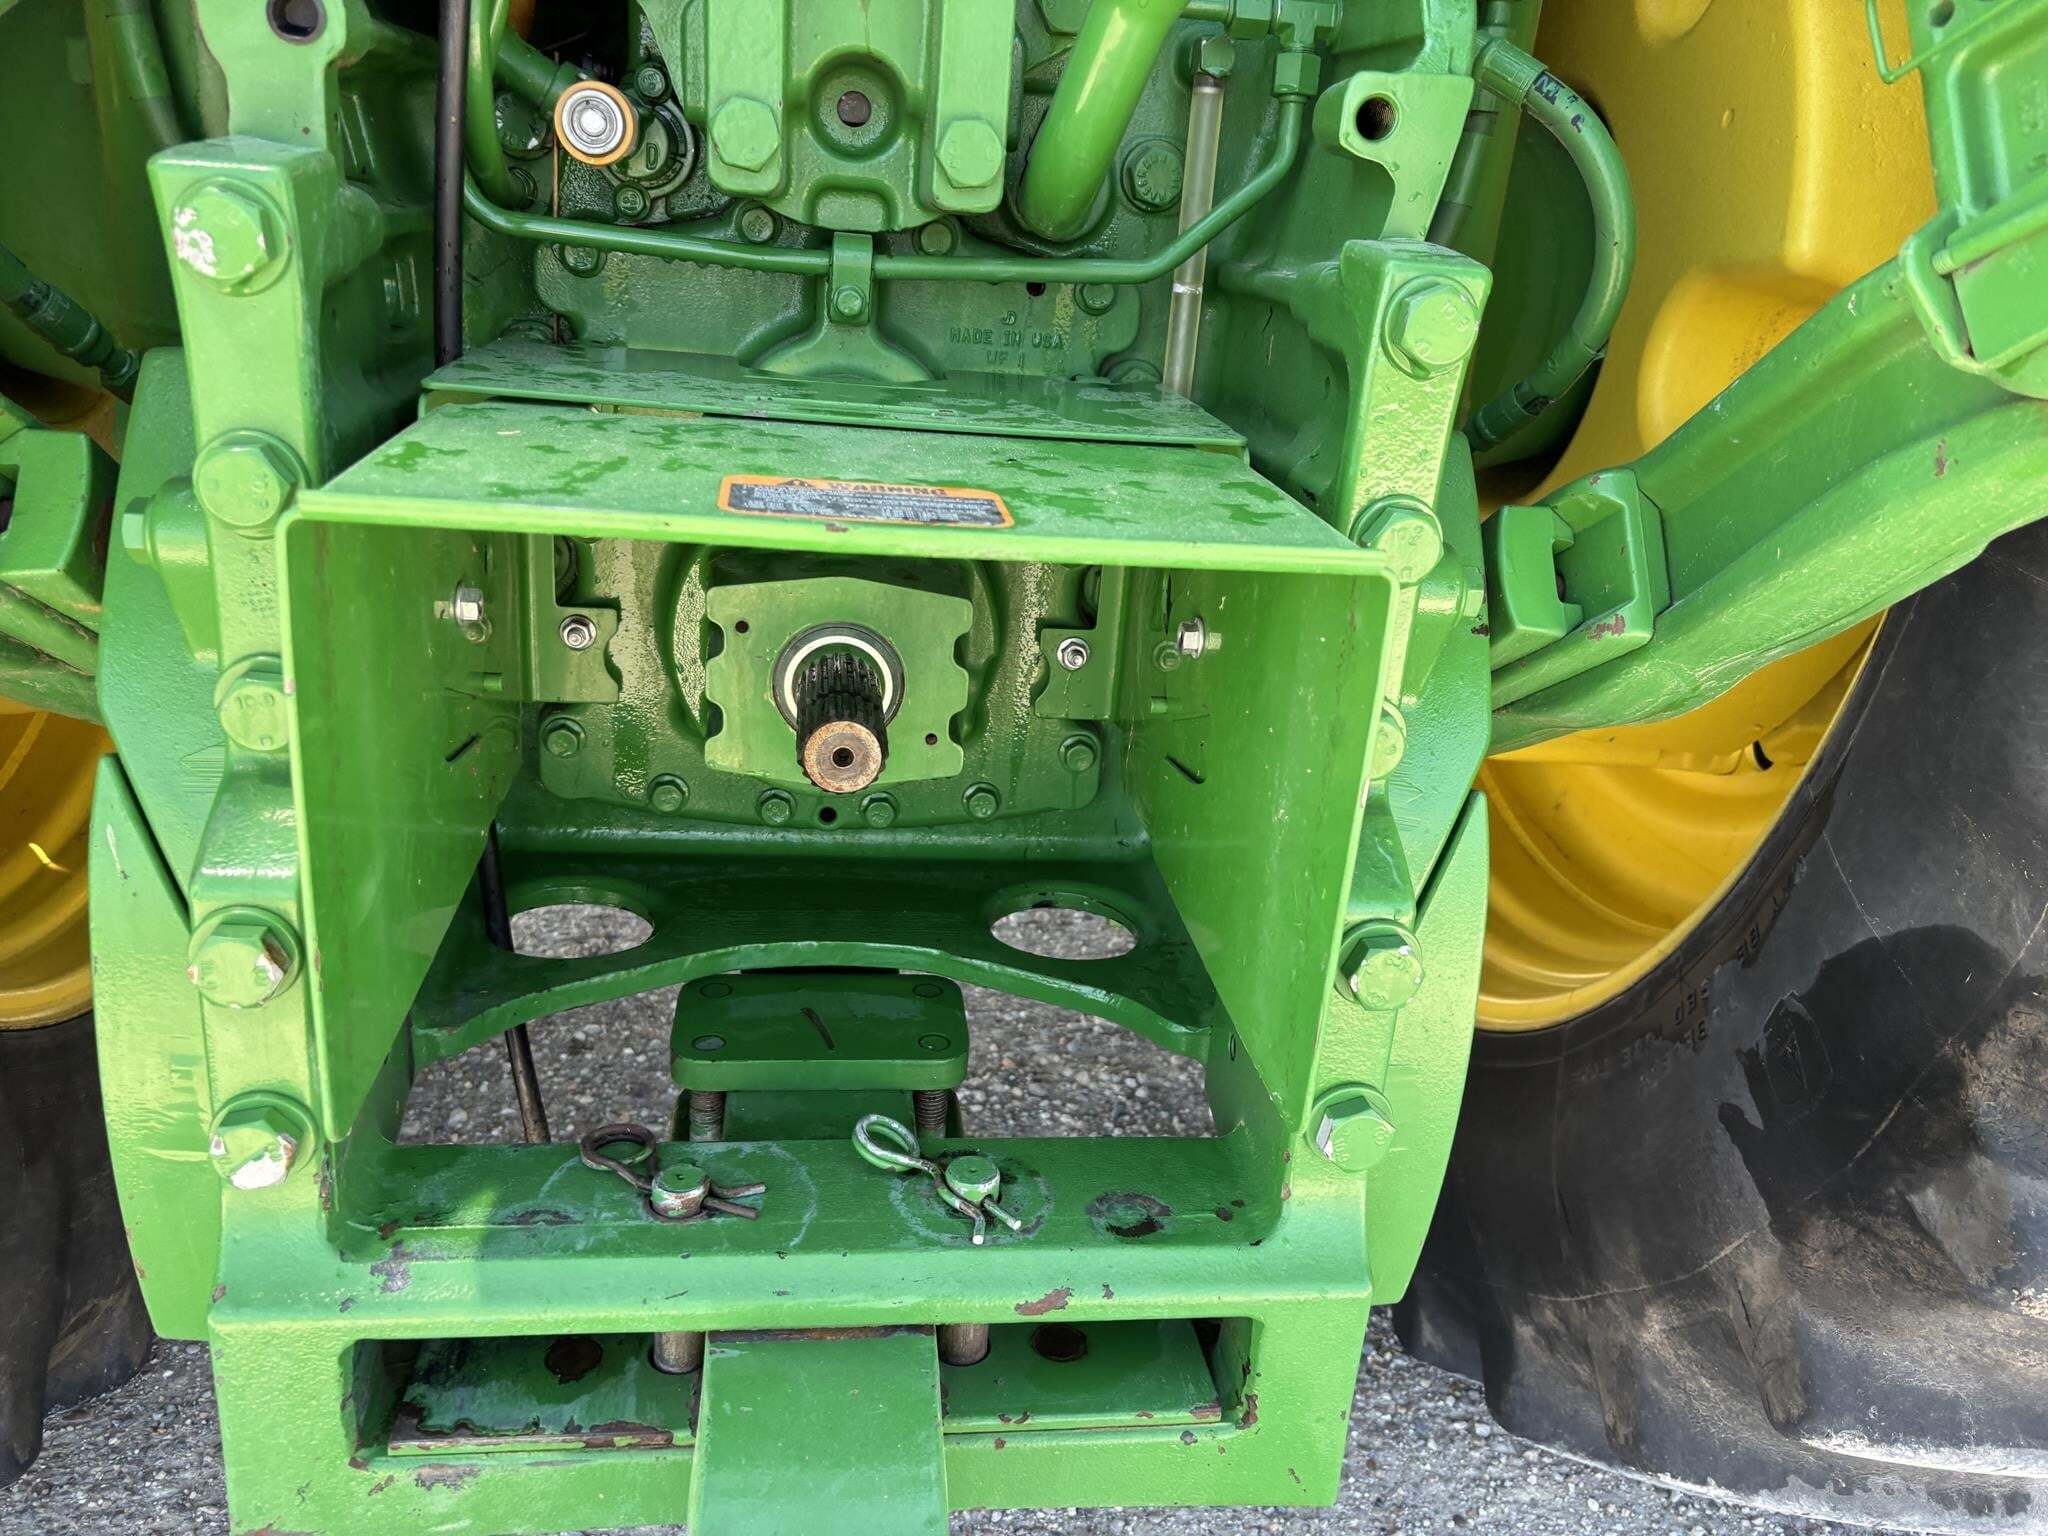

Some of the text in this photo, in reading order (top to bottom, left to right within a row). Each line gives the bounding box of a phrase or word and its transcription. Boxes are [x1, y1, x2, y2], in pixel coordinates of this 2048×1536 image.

[949, 326, 1066, 350] MADE IN USA
